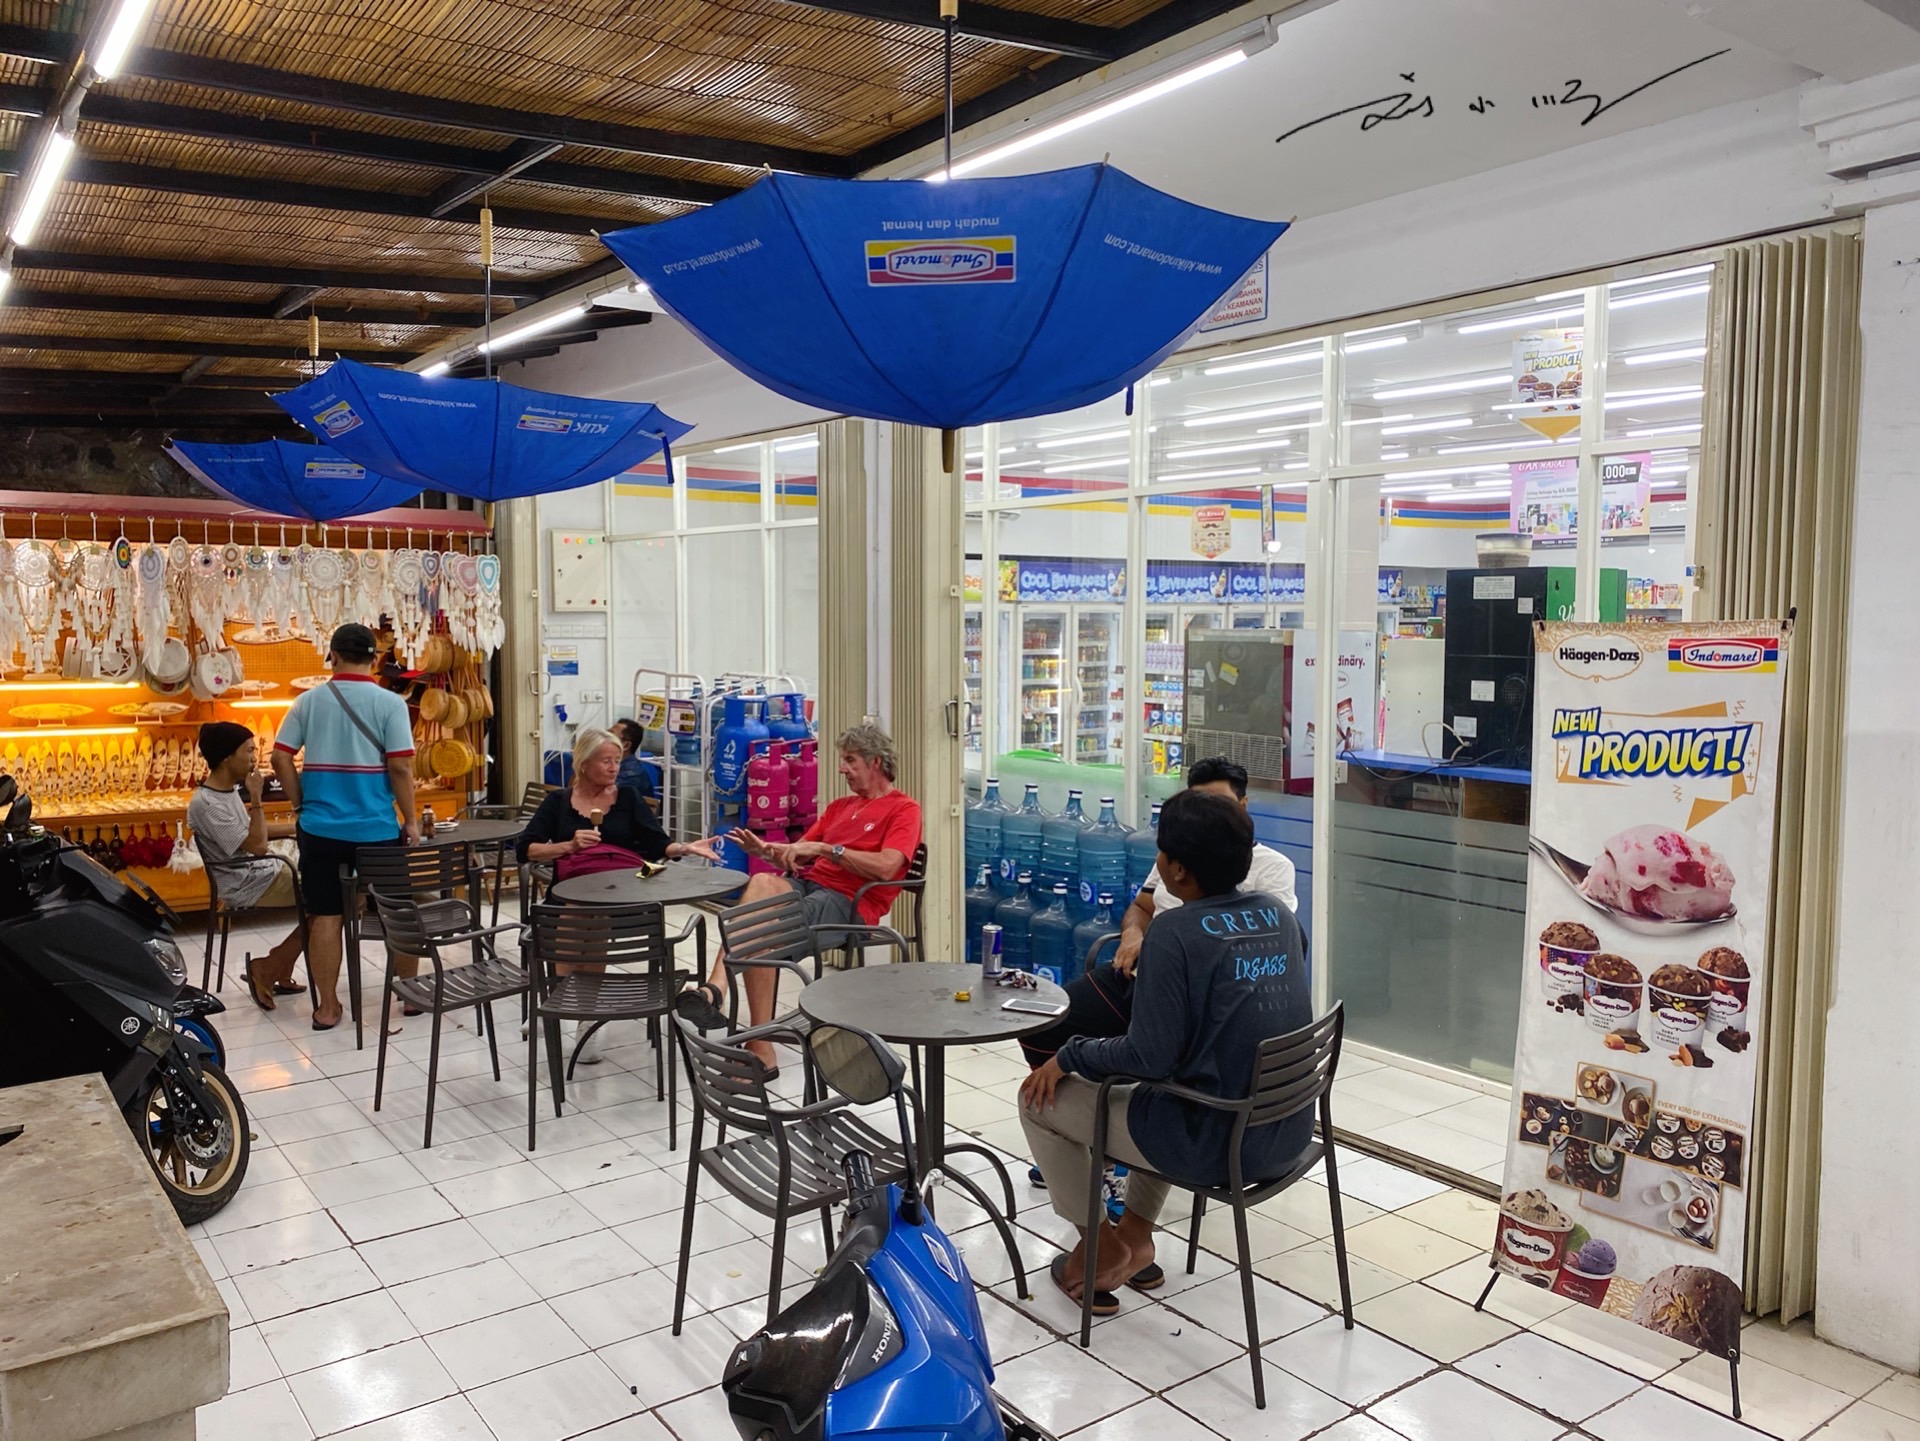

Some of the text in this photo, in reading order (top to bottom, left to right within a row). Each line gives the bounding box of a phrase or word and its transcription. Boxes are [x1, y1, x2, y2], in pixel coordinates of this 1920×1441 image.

[882, 217, 1000, 232] mudah dan hemat
[663, 238, 763, 275] www.indomaret.co.id
[895, 253, 989, 270] Indomaret
[1103, 233, 1223, 274] www.klikindomaret.com
[1227, 297, 1263, 311] KEAMANAN
[1244, 306, 1263, 317] ANDA
[1531, 351, 1583, 371] PRODUCT!
[1021, 571, 1107, 591] COOL BEVERAGES
[1159, 573, 1209, 592] BEVERAGES
[1233, 575, 1258, 591] COOL
[1560, 647, 1640, 664] Häagen-Dazs
[1687, 648, 1759, 663] Indomaret
[1553, 708, 1600, 737] NEW
[1580, 725, 1752, 777] PRODUCT!
[1201, 907, 1280, 935] CREW
[1551, 965, 1584, 978] Häagen-Da
[1657, 1100, 1747, 1130] EVERY KIND OF EXTRAORDINARY
